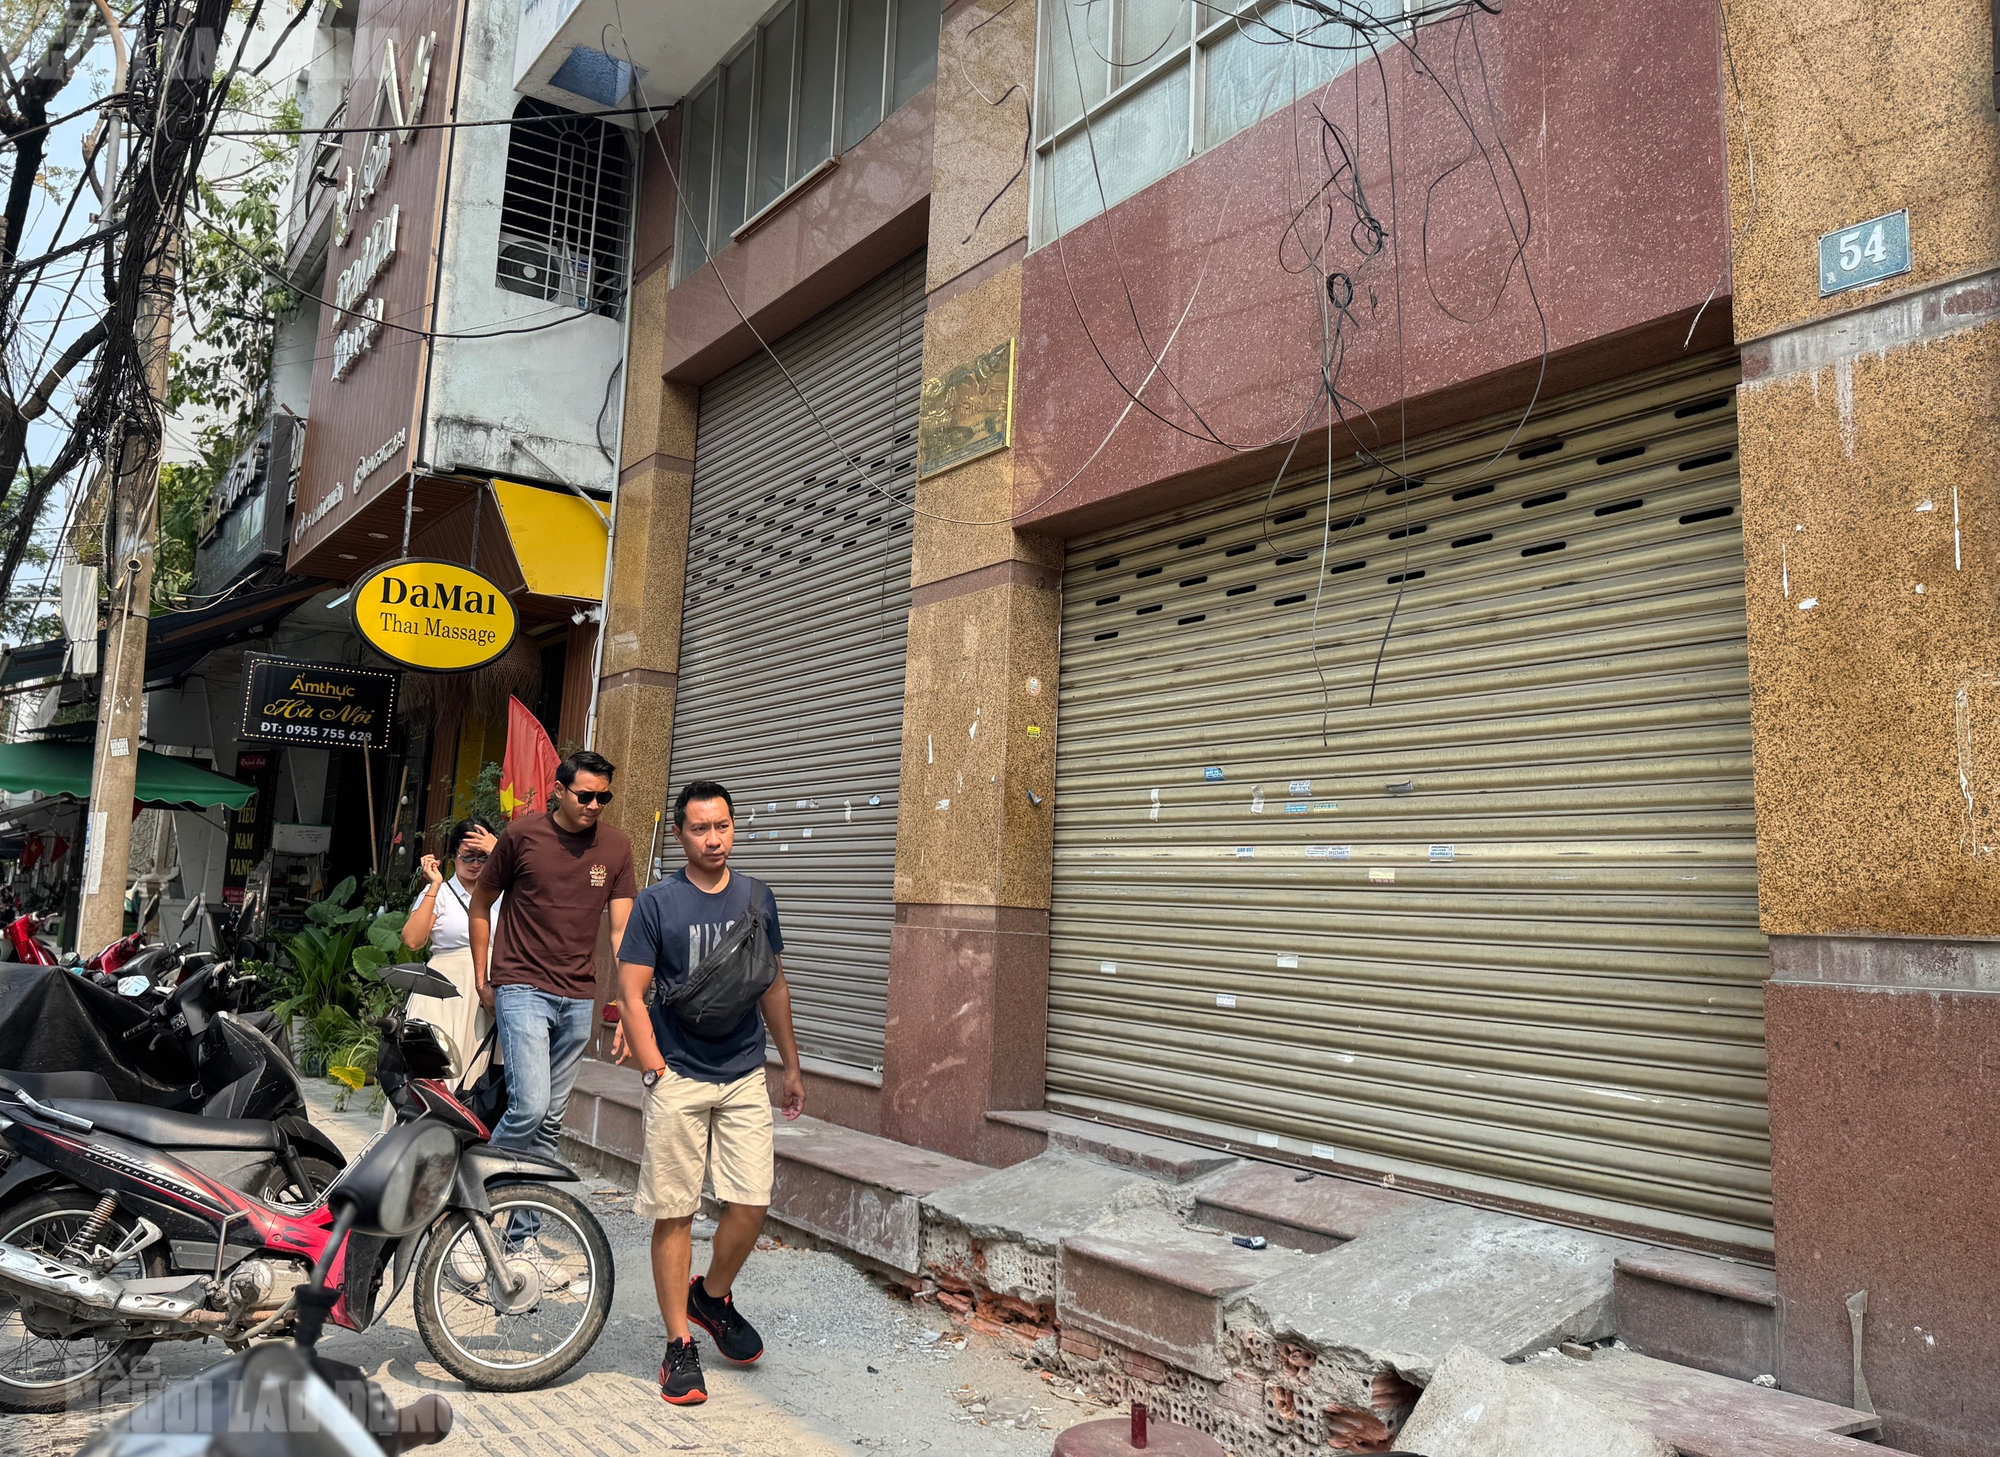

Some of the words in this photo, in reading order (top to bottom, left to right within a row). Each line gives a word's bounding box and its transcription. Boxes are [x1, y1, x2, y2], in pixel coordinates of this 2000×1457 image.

[1840, 224, 1887, 271] 54
[380, 577, 496, 616] DaMai
[380, 612, 419, 636] Thai
[424, 617, 496, 647] Massage
[263, 699, 314, 719] Hà
[319, 704, 375, 726] Nội
[260, 722, 282, 733] ĐT:
[286, 724, 318, 736] 0935
[322, 727, 345, 739] 755
[349, 731, 372, 742] 628
[234, 832, 253, 850] NAM
[230, 858, 253, 876] VANG
